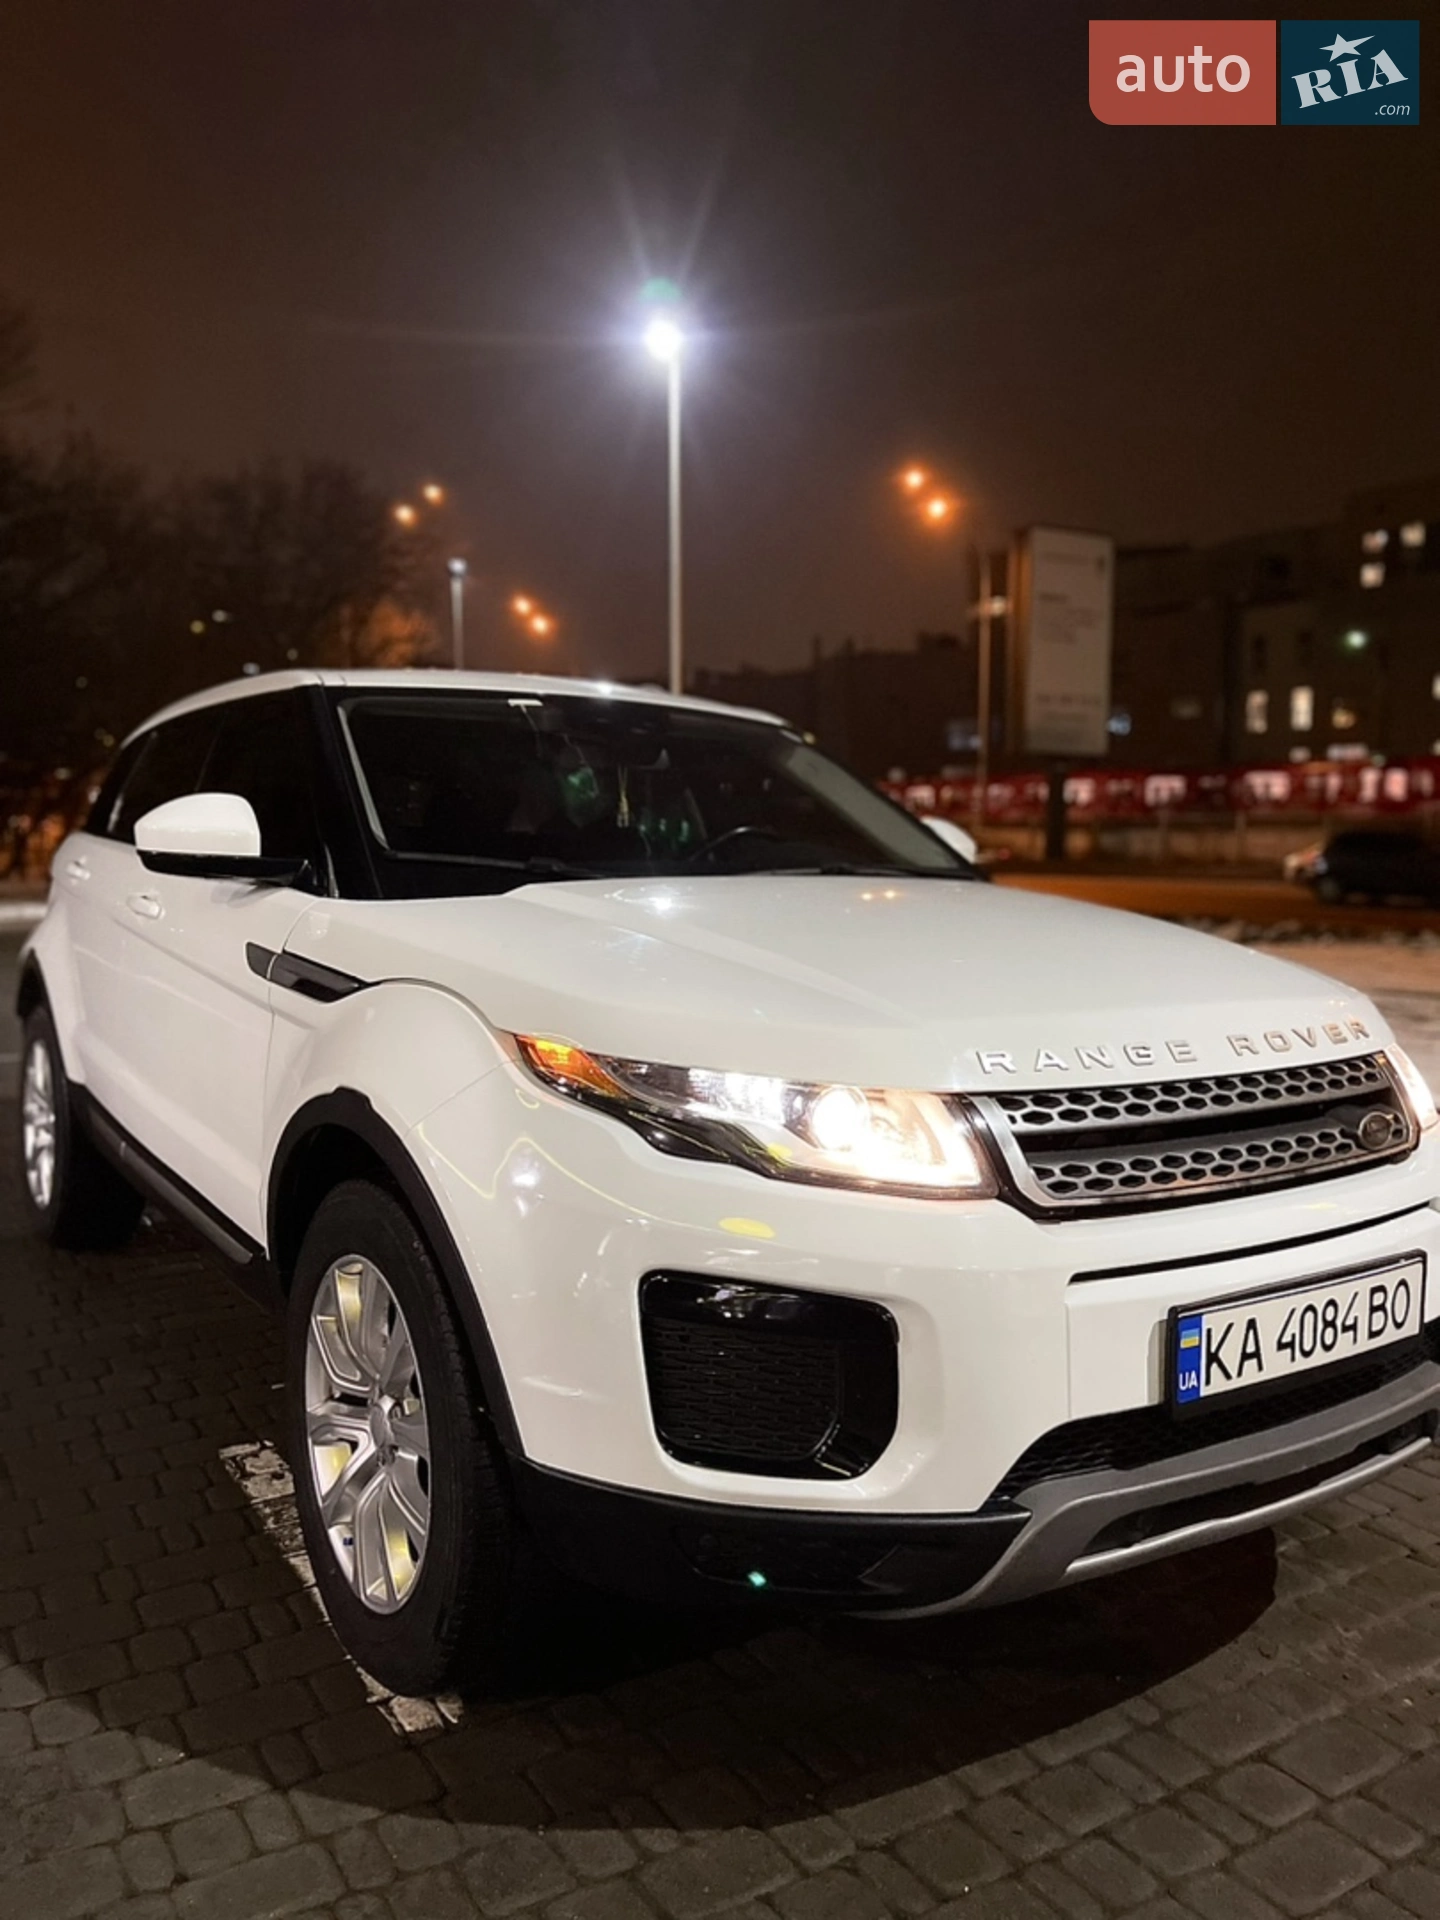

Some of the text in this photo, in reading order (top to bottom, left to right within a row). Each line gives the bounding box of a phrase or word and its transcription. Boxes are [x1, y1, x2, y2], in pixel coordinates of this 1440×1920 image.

[977, 1019, 1370, 1074] RANGE ROVER
[1204, 1317, 1263, 1387] KA
[1179, 1370, 1198, 1390] UA
